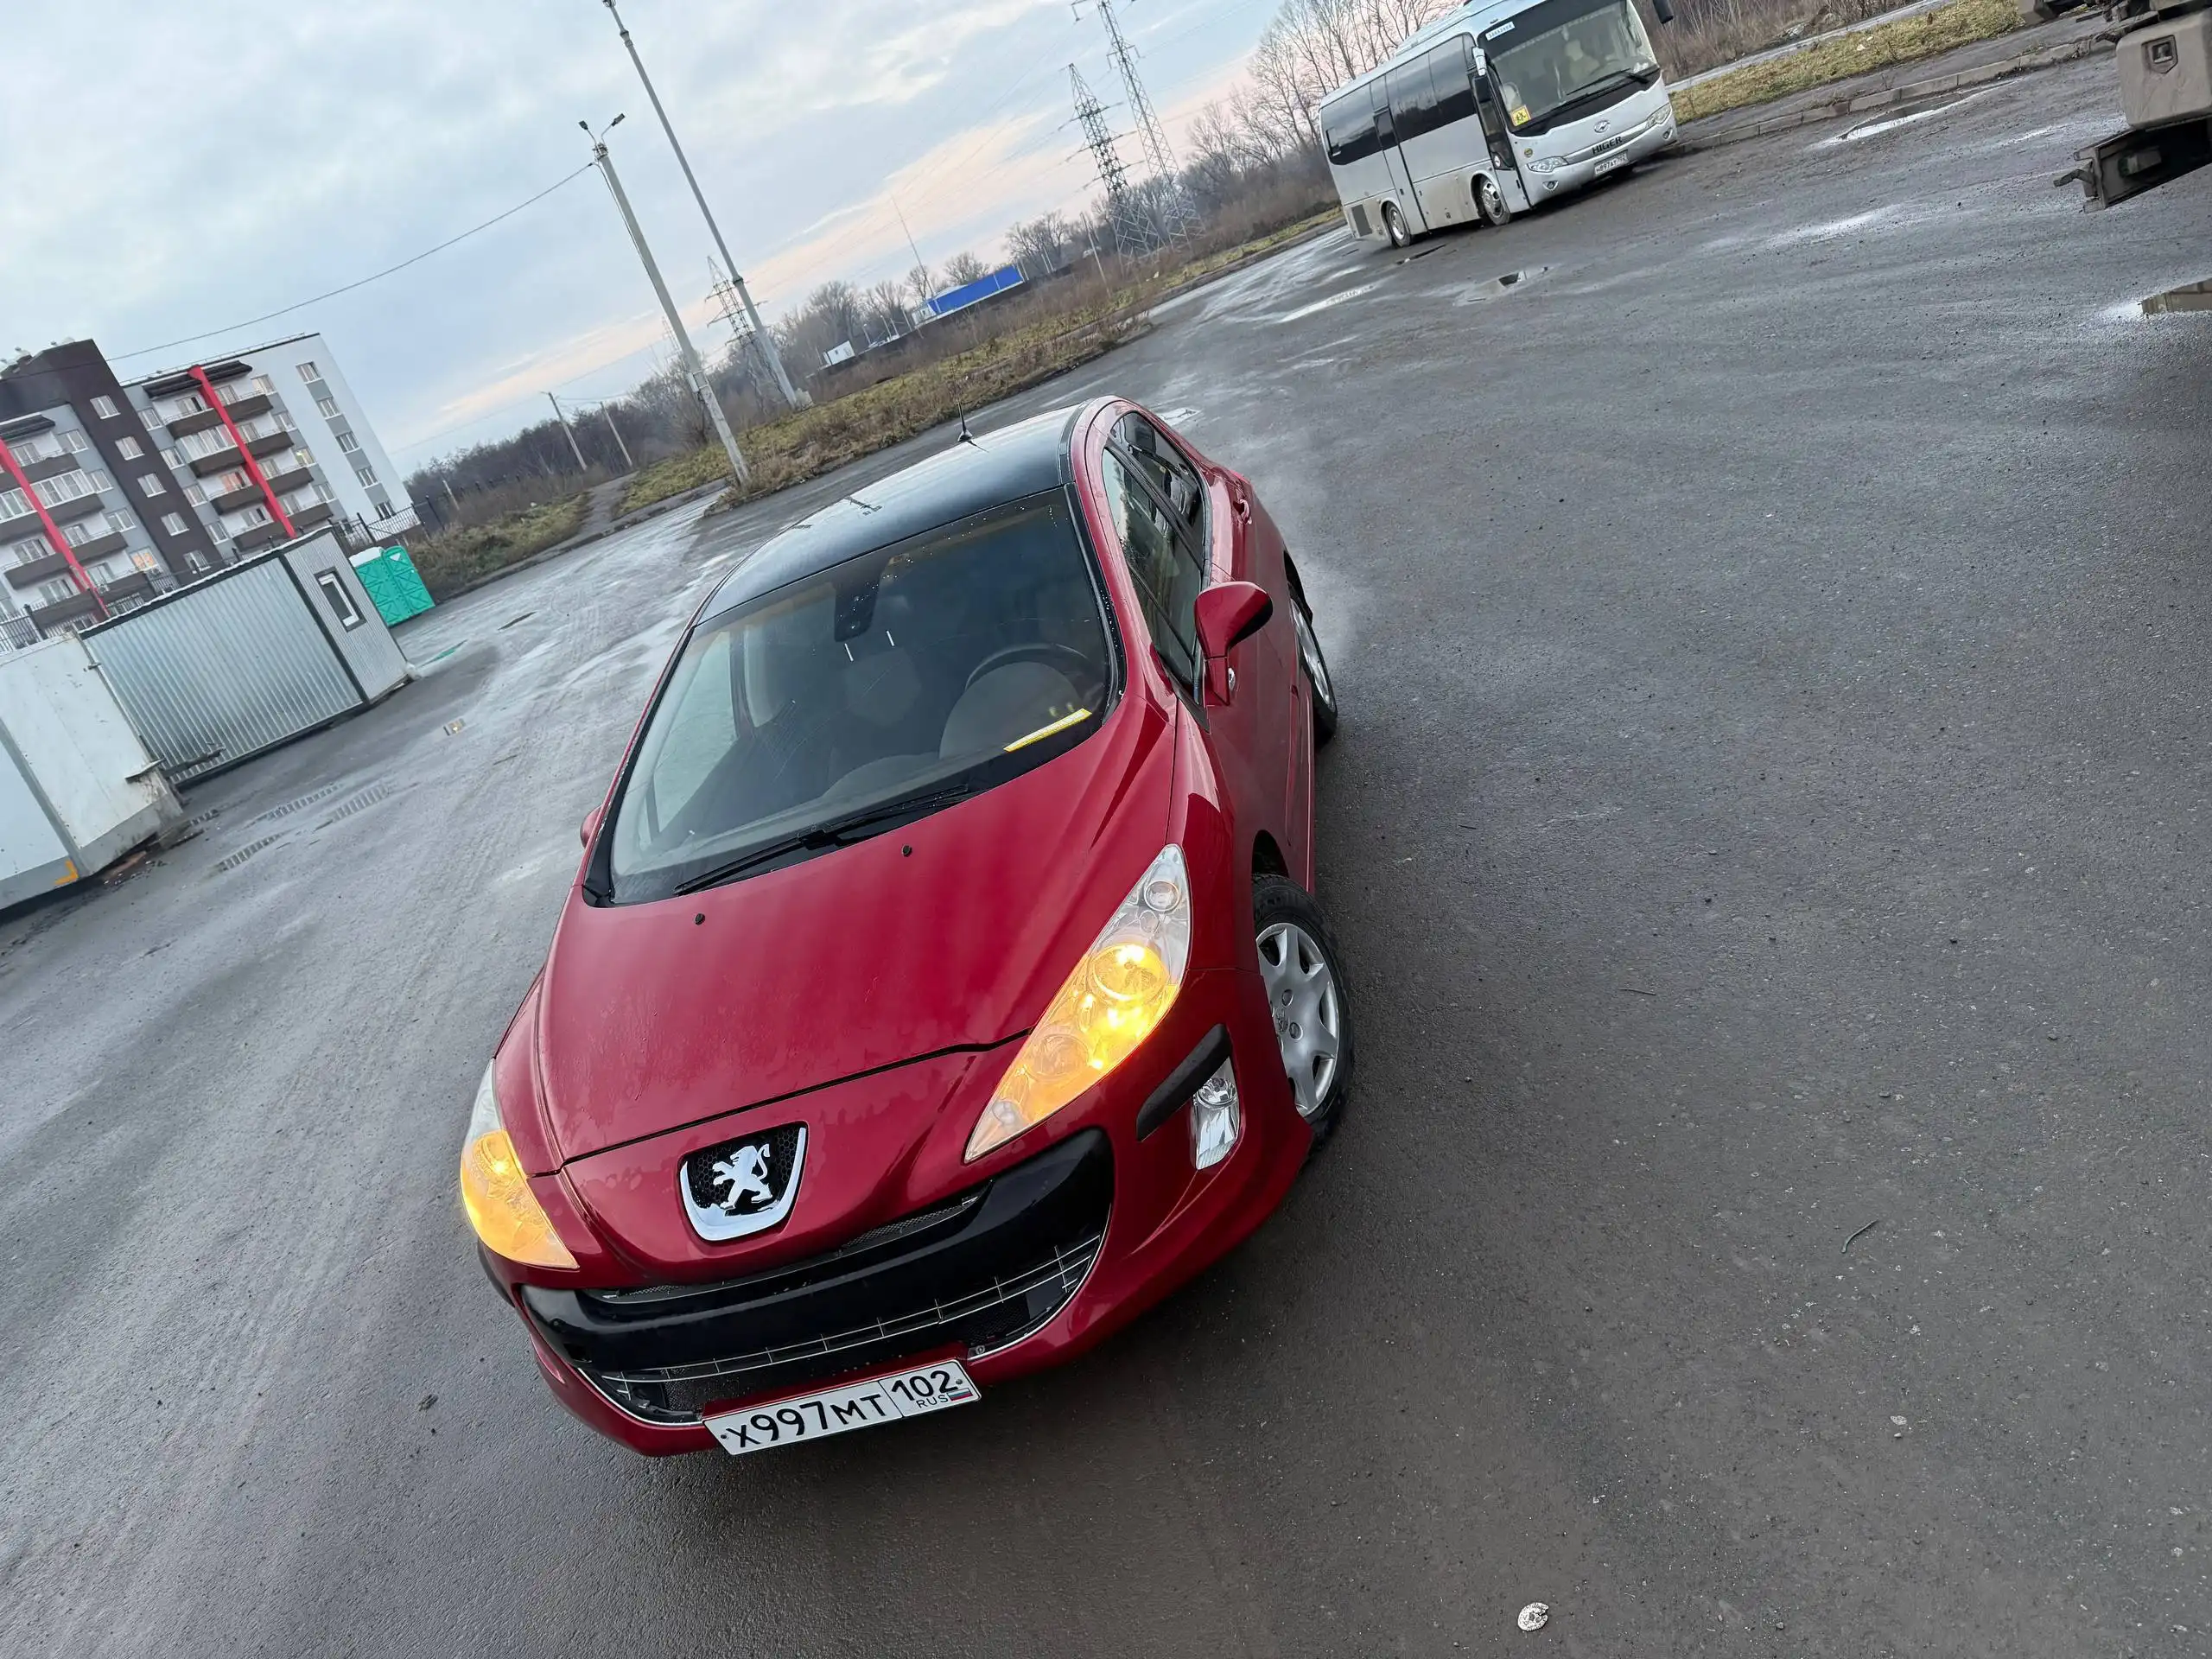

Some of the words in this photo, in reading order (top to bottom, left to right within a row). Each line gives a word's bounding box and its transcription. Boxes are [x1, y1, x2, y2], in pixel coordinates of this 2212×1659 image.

[1592, 137, 1623, 154] HIGER
[726, 1394, 887, 1447] Х997МТ
[891, 1370, 958, 1401] 102
[916, 1395, 949, 1408] RUS
